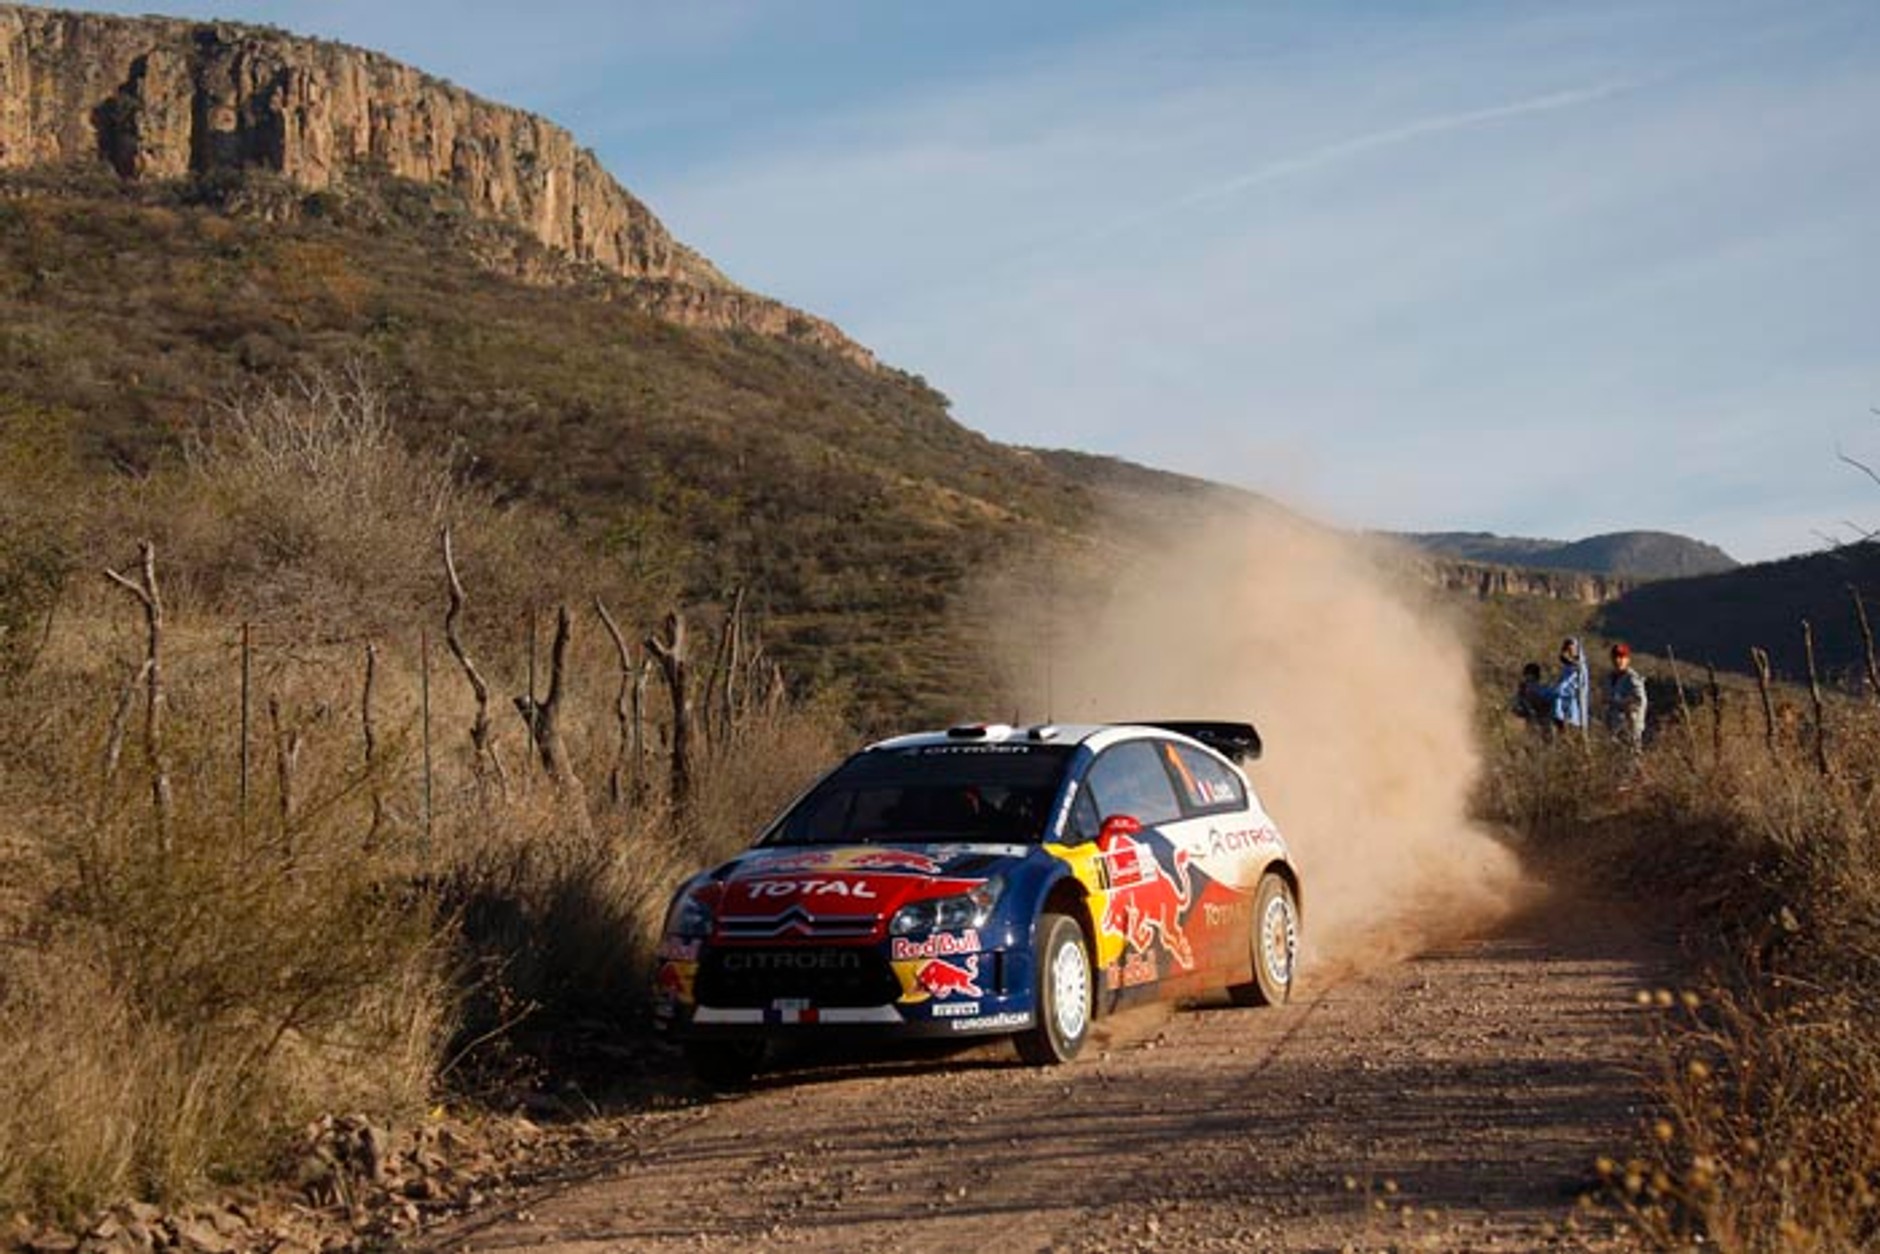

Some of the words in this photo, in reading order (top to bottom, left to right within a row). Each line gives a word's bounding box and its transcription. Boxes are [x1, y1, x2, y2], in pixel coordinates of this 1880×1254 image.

[748, 880, 877, 898] TOTAL
[892, 934, 938, 959] Red
[938, 929, 981, 956] Bull
